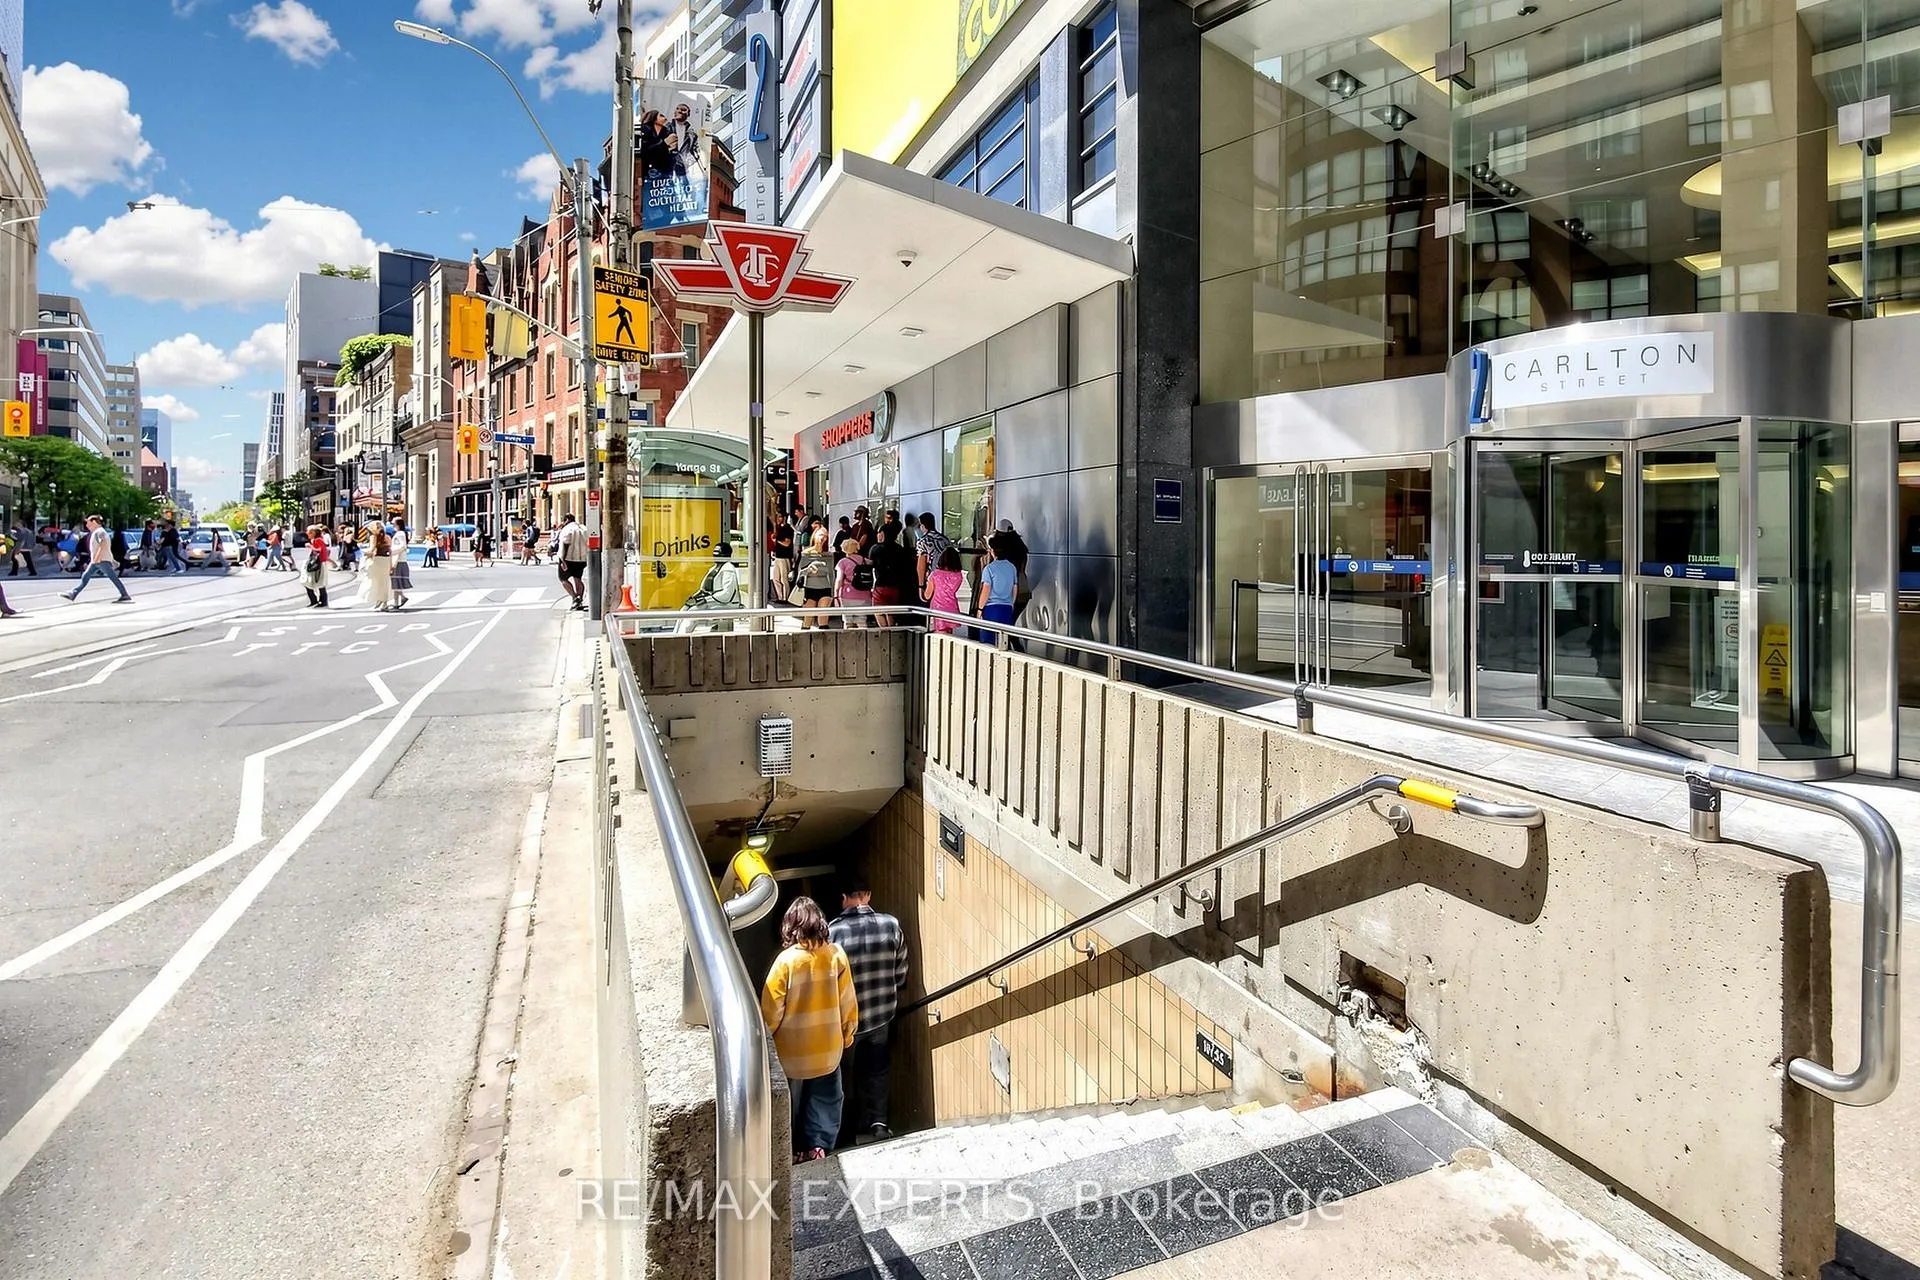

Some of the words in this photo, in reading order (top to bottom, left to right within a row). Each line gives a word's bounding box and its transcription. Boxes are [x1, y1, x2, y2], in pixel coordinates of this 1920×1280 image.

[736, 243, 780, 287] TTC
[595, 280, 625, 294] SAFETY
[1504, 343, 1696, 381] CARLTON
[1540, 373, 1648, 392] STREET
[821, 410, 874, 449] SHOPPERS
[709, 464, 721, 473] St
[654, 533, 711, 557] Drinks
[257, 623, 432, 636] STOP
[232, 641, 380, 657] TTC
